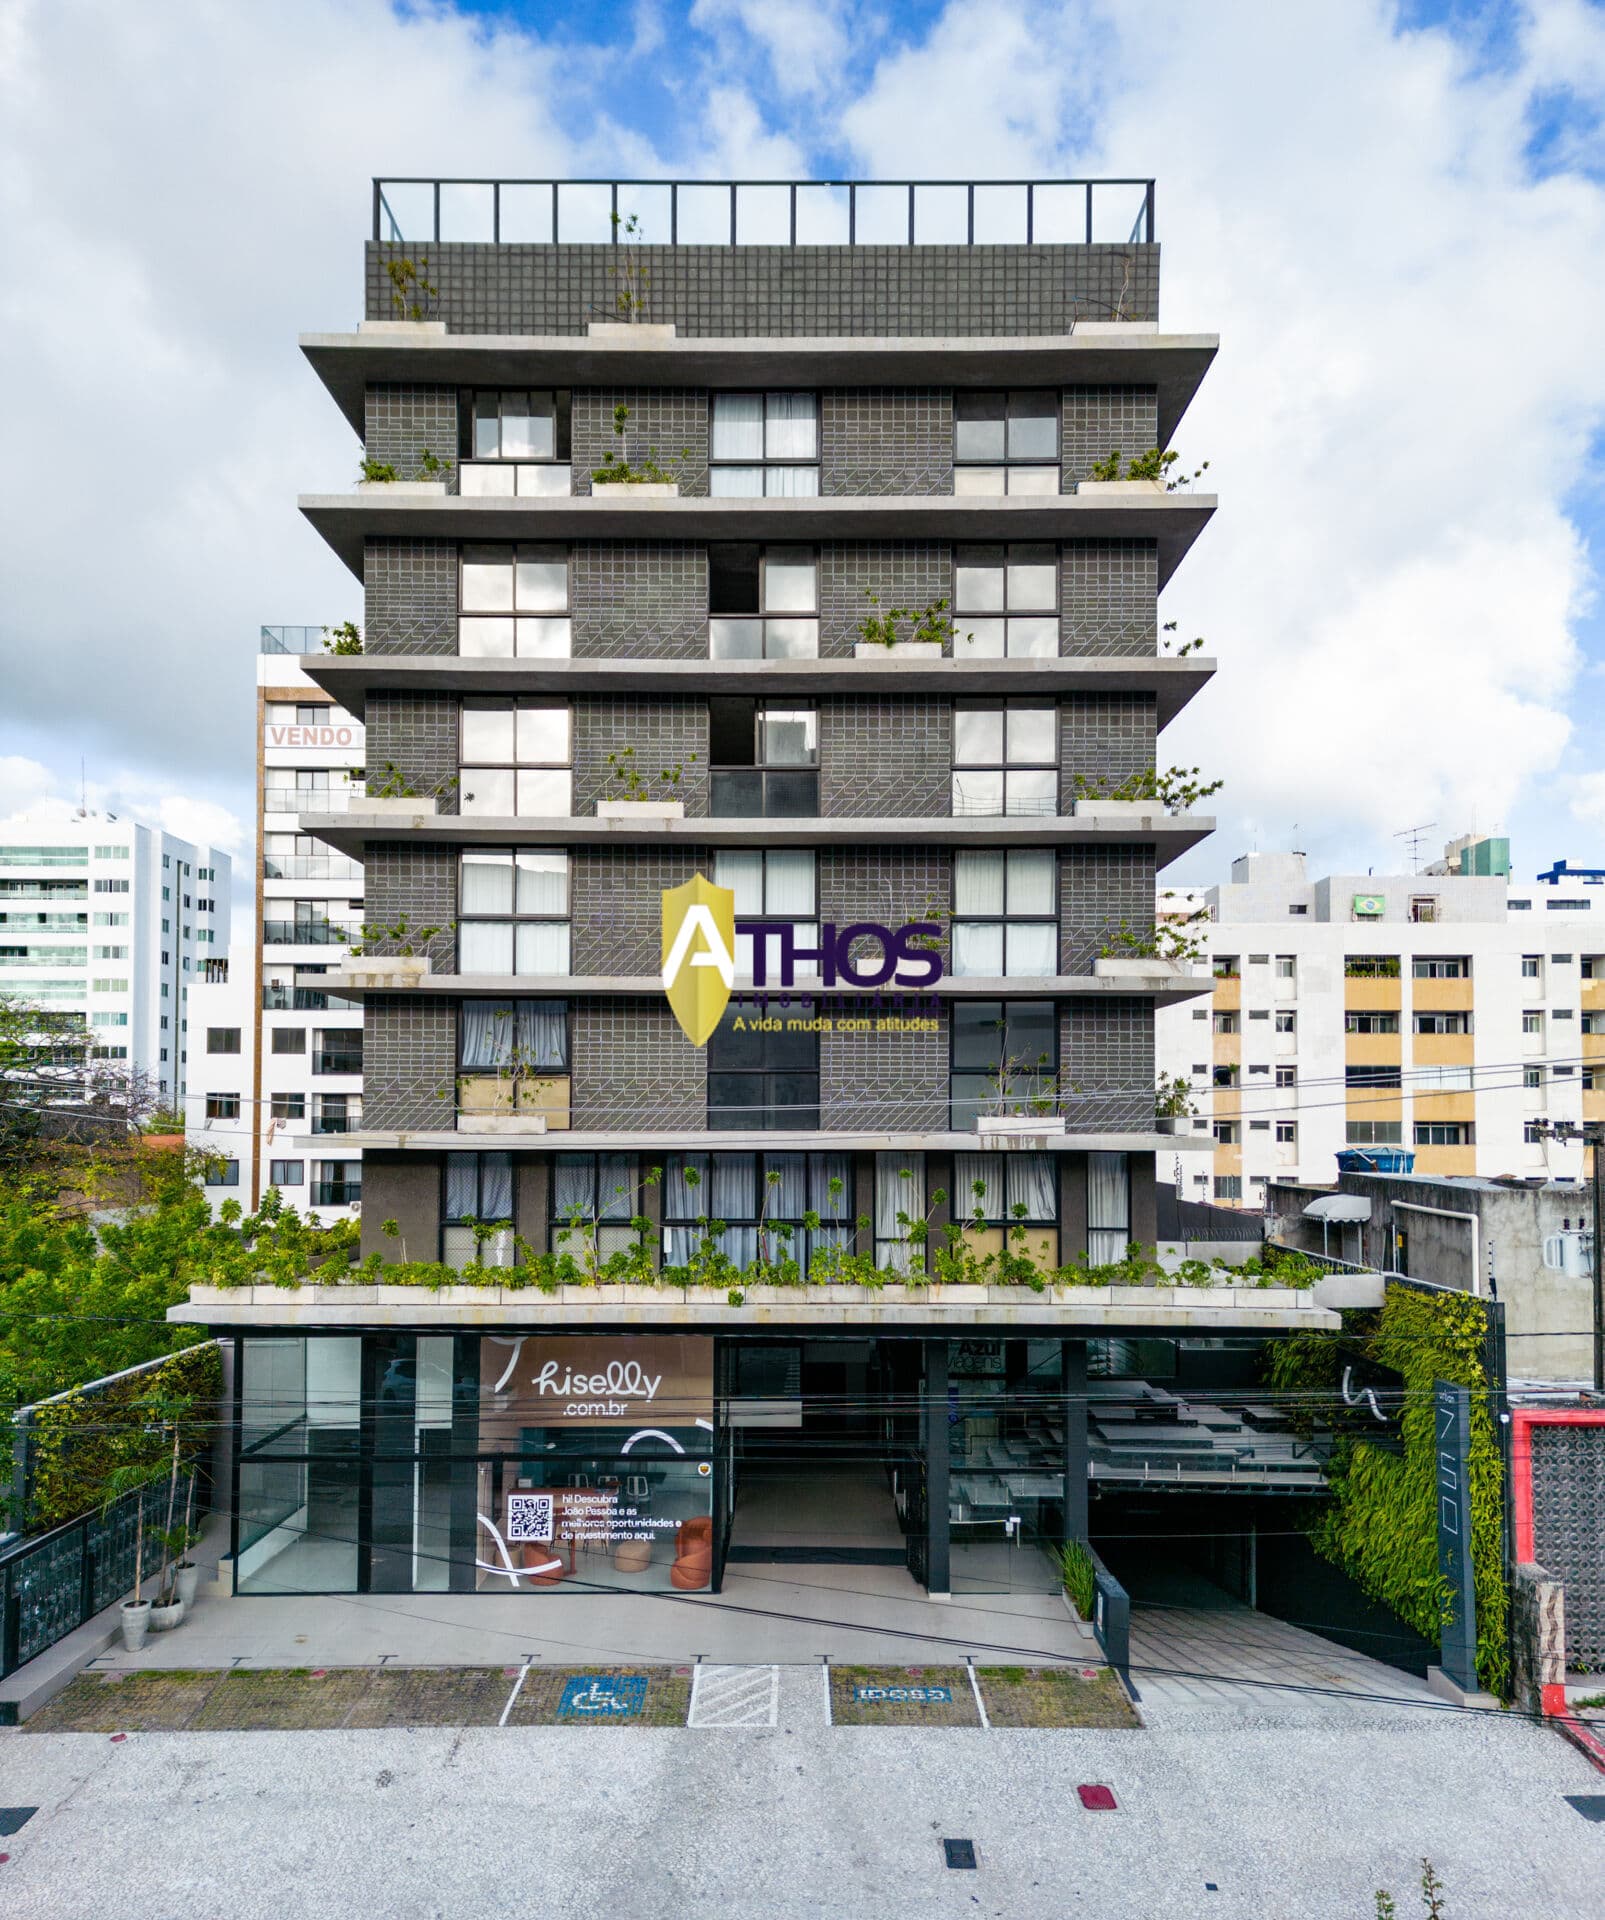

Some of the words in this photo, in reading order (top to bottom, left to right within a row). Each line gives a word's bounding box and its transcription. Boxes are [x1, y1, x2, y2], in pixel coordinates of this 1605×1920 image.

[271, 727, 353, 747] VENDO
[958, 1341, 1001, 1356] Azul
[531, 1360, 662, 1403] hiselly
[562, 1400, 629, 1416] .com.br
[562, 1494, 573, 1504] hi!
[574, 1494, 619, 1504] Descubra
[561, 1505, 584, 1516] João
[585, 1506, 618, 1516] Pessoa
[626, 1508, 637, 1516] as
[561, 1517, 606, 1528] melhores
[606, 1517, 675, 1530] oportunidades
[560, 1531, 575, 1540] de
[575, 1531, 633, 1540] investimento
[633, 1530, 656, 1542] aqui.
